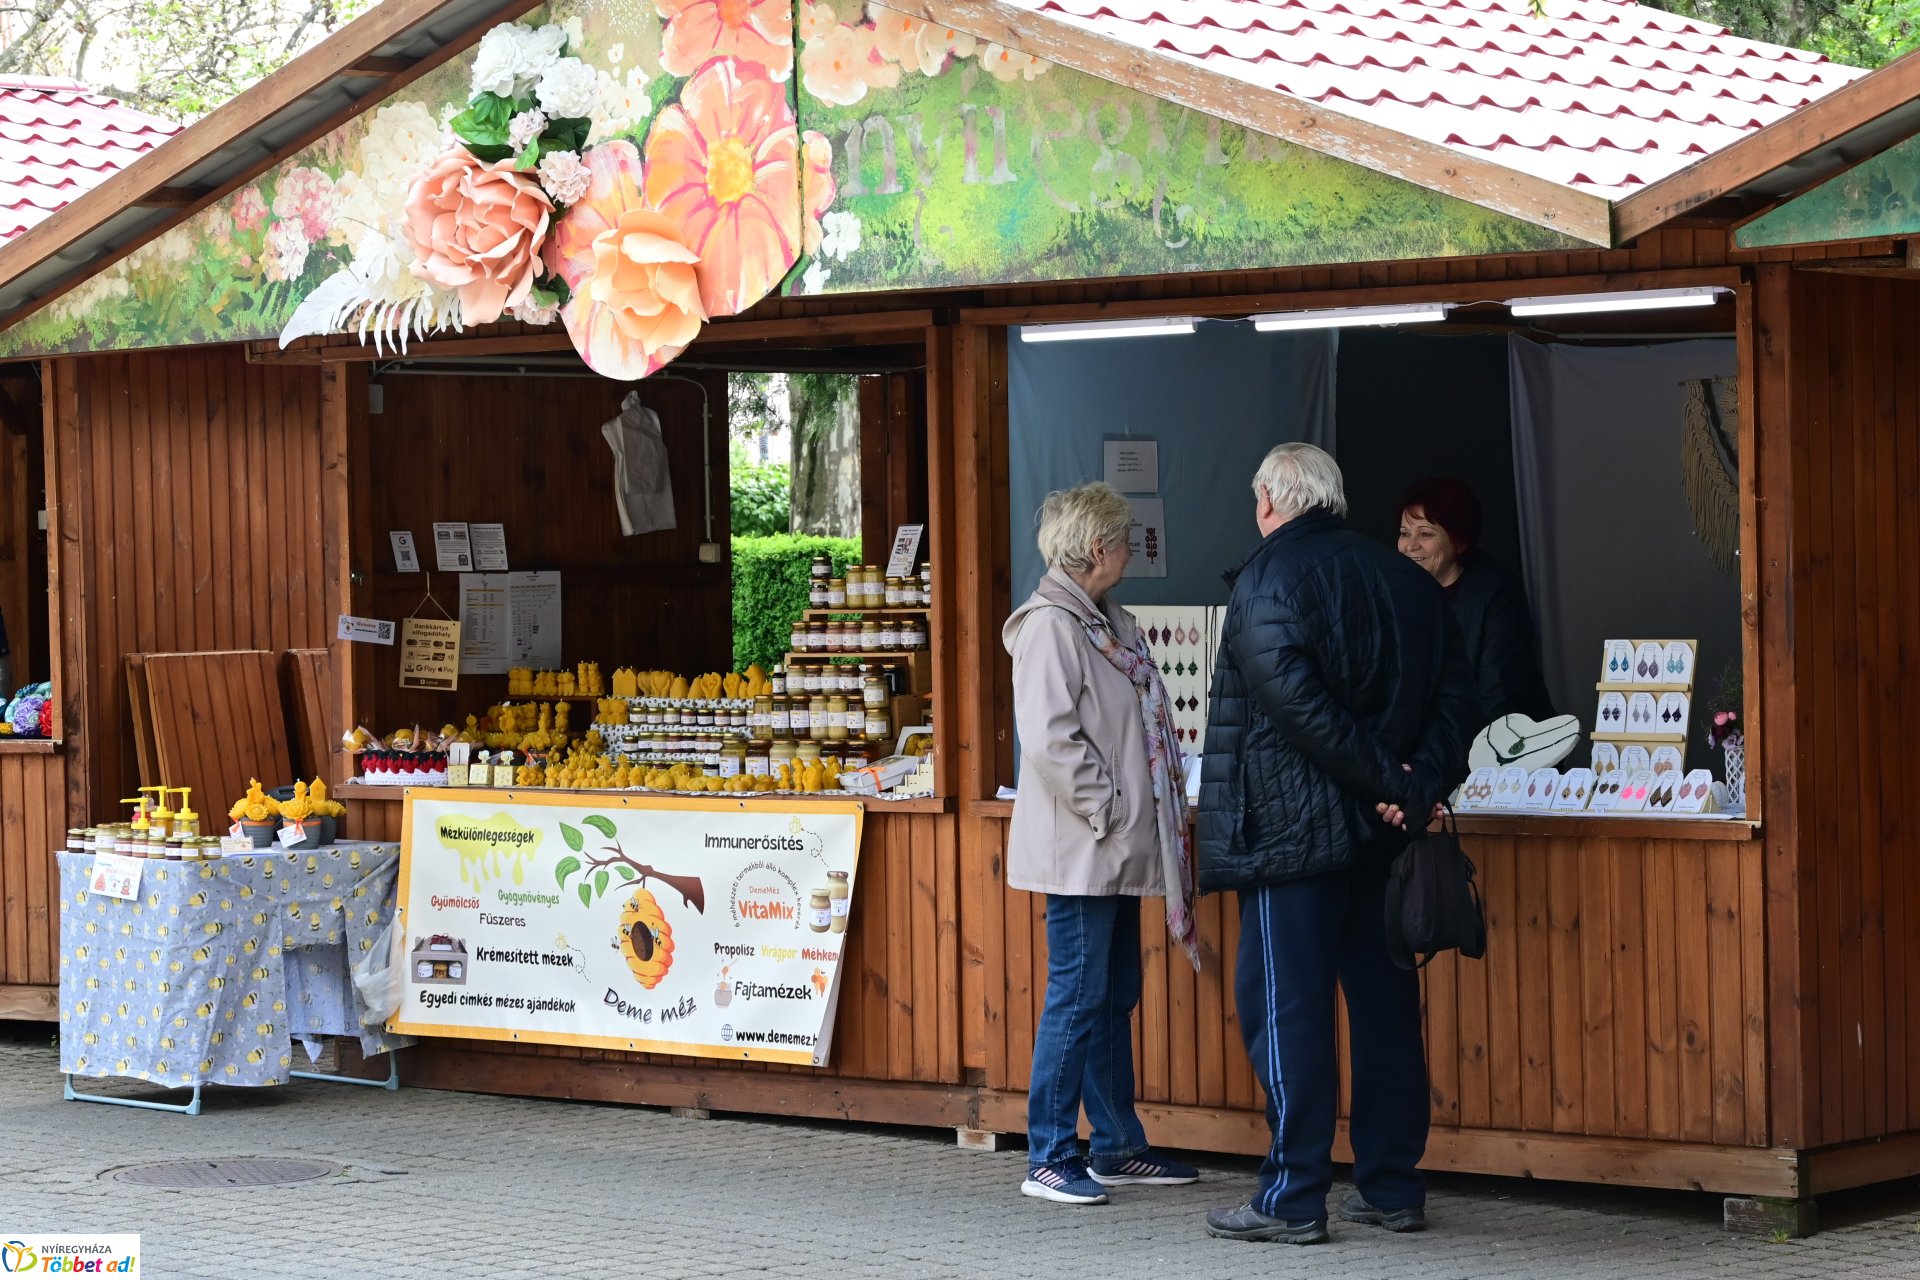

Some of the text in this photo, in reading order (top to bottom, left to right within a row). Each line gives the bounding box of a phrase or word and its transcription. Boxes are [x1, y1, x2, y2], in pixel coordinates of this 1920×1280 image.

[414, 623, 449, 631] Bankkártya
[440, 825, 535, 848] Mézkülönlegességek
[704, 833, 804, 851] Immunerősítés
[735, 860, 764, 881] termékből
[765, 861, 777, 872] álló
[777, 867, 799, 896] komplex
[497, 888, 560, 908] Gyógynövényes
[748, 885, 780, 895] DemeMéz
[430, 894, 480, 911] Gyümölcsös
[738, 899, 794, 921] VitaMix
[479, 912, 526, 927] Fűszeres
[476, 945, 574, 968] Krémesített mézek
[714, 942, 755, 959] Propolisz
[761, 944, 797, 962] Virágpor
[734, 980, 812, 1001] Fajtamézek
[419, 989, 576, 1014] Egyedi címkés mézes ajándékok
[603, 987, 697, 1024] Deme méz
